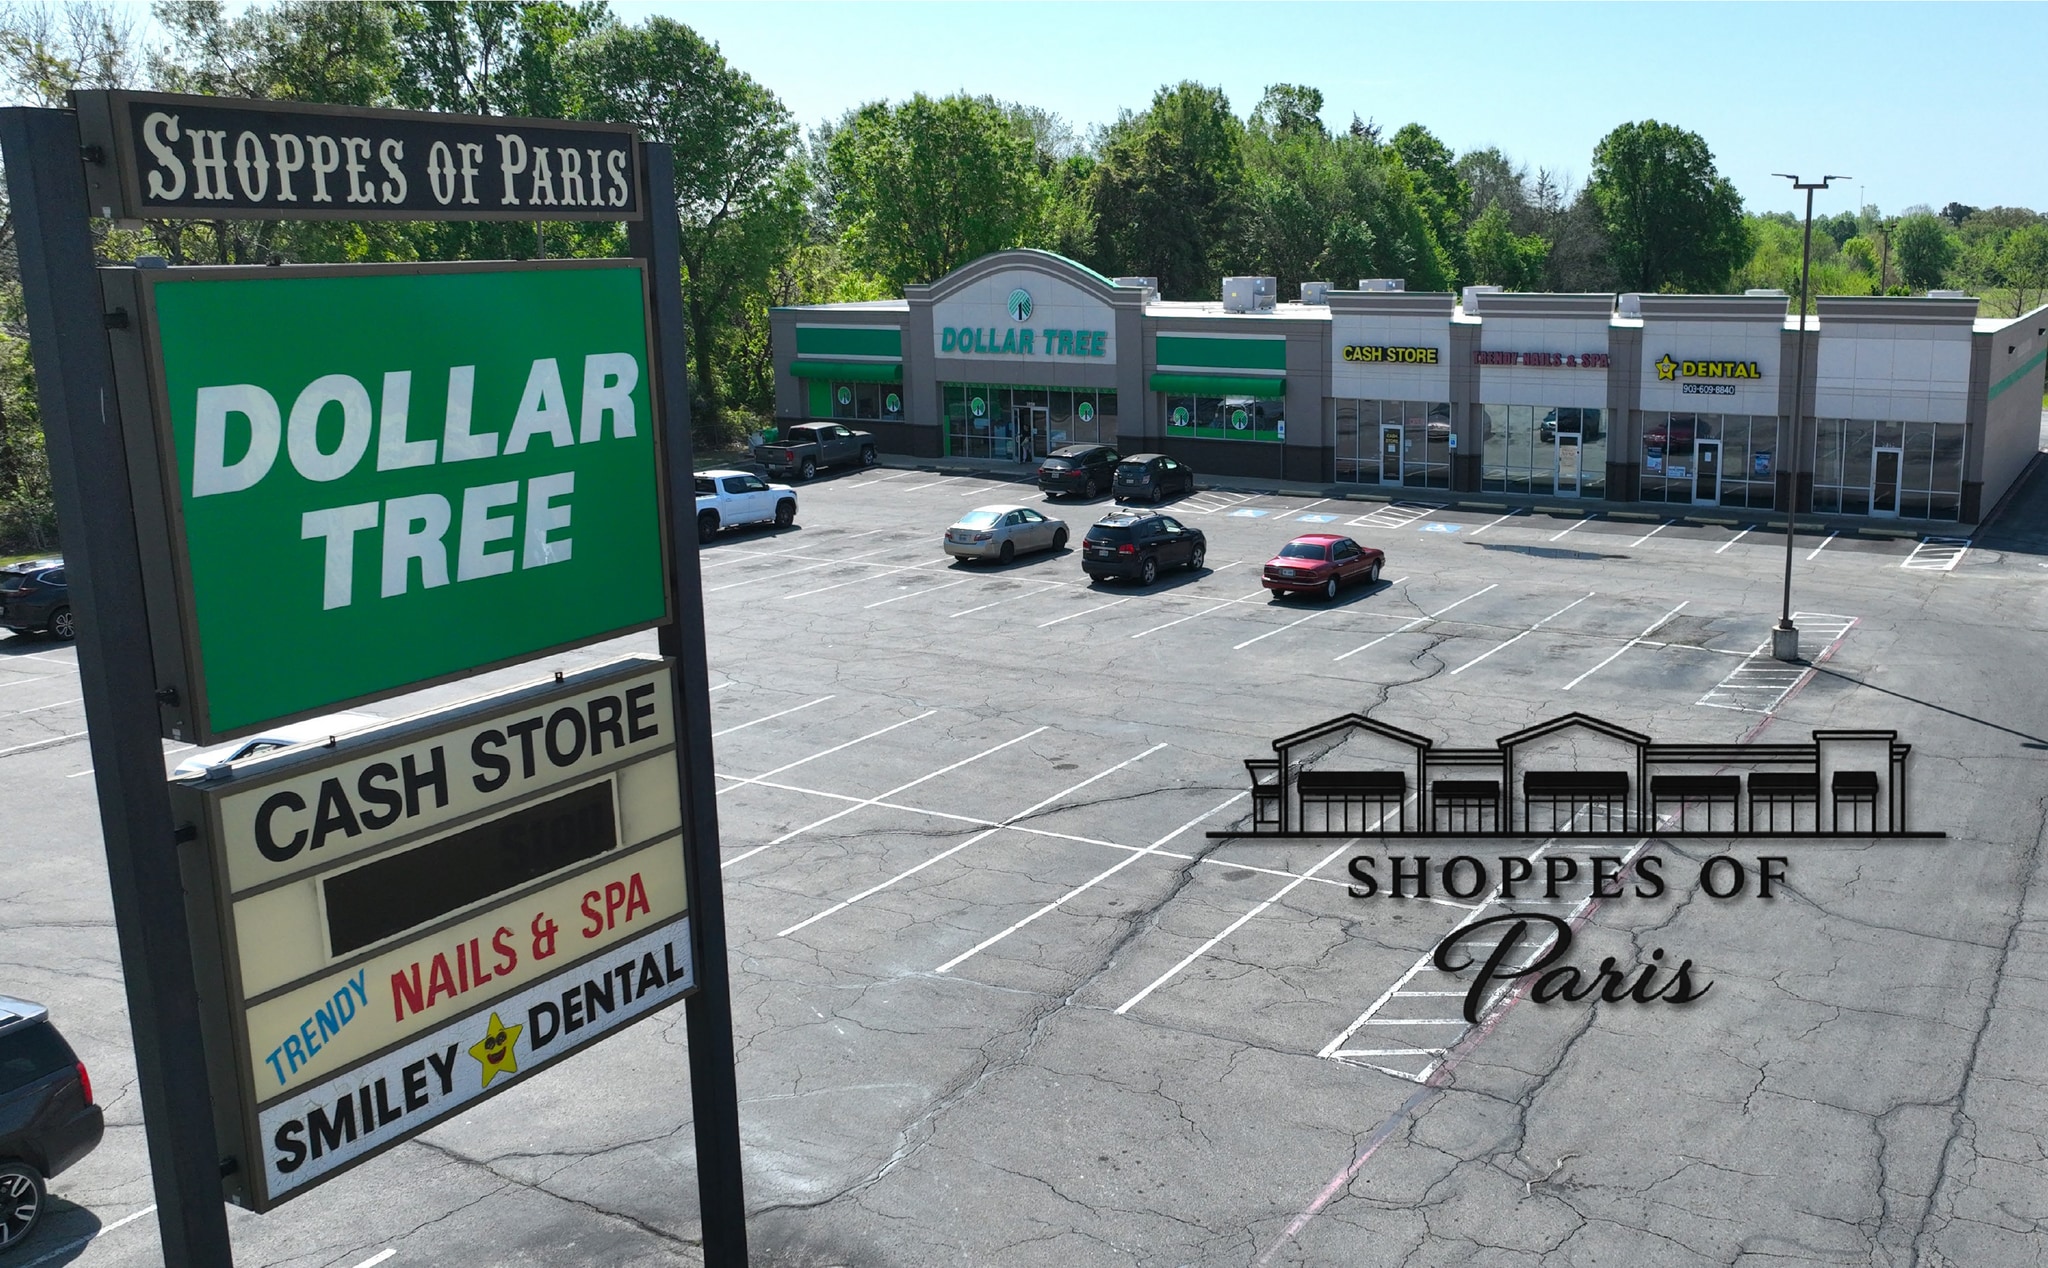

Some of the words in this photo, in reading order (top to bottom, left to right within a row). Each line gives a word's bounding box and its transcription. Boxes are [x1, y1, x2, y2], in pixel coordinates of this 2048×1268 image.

[143, 111, 407, 203] SHOPPES
[427, 142, 484, 205] OF
[497, 134, 629, 207] PARIS
[941, 327, 1034, 354] DOLLAR
[1043, 329, 1107, 357] TREE
[1342, 345, 1383, 361] CASH
[1386, 346, 1438, 364] STORE
[1473, 351, 1518, 365] TRENDY
[1523, 352, 1562, 367] NAILS
[1566, 354, 1577, 367] &
[1581, 353, 1609, 368] SPA
[1682, 361, 1761, 379] DENTAL
[1683, 384, 1735, 395] 903-609-8840
[192, 352, 639, 498] DOLLAR
[301, 471, 575, 610] TREE
[255, 746, 449, 862] CASH
[471, 683, 659, 793] STORE
[265, 969, 369, 1086] TRENDY
[390, 926, 518, 1024] NAILS
[532, 912, 559, 961] &
[580, 873, 651, 939] SPA
[274, 1043, 459, 1174] SMILEY
[528, 942, 684, 1050] DENTAL
